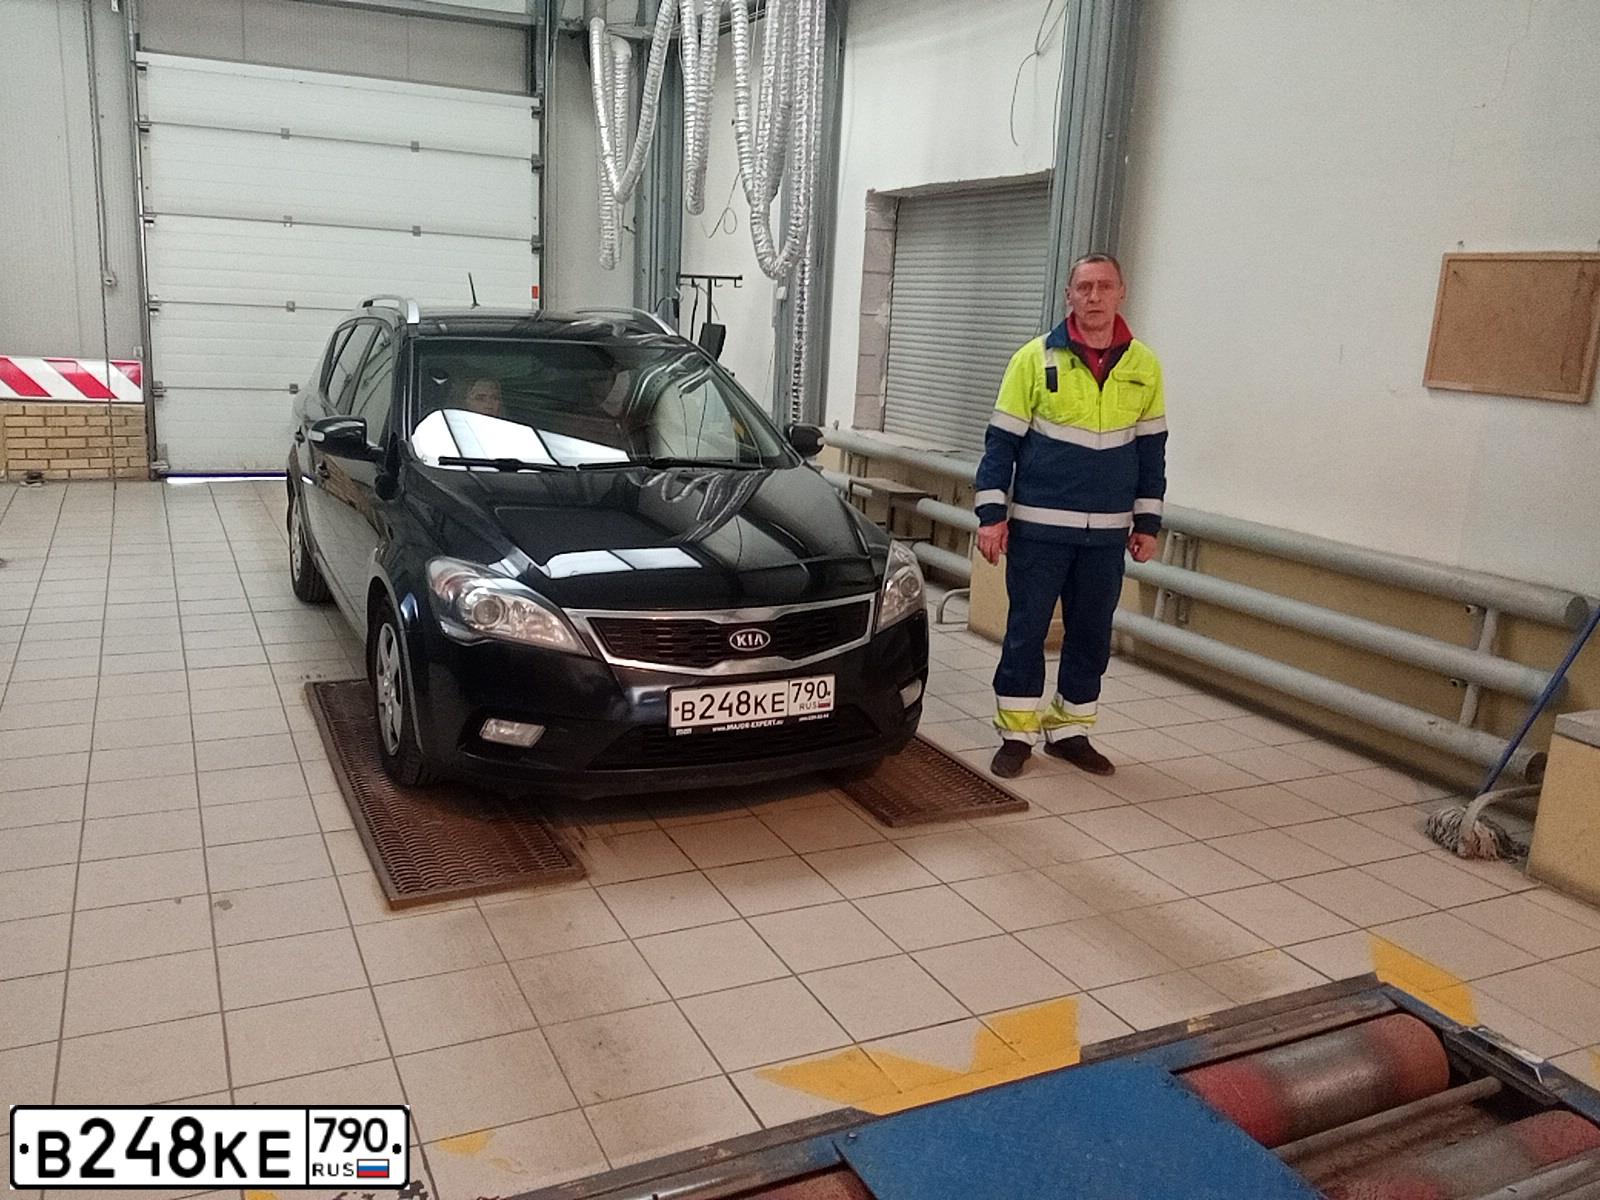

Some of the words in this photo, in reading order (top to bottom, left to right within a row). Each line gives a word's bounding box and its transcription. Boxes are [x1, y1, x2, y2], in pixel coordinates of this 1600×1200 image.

[736, 633, 764, 647] KIA
[791, 680, 828, 703] 790
[799, 701, 818, 711] RUS
